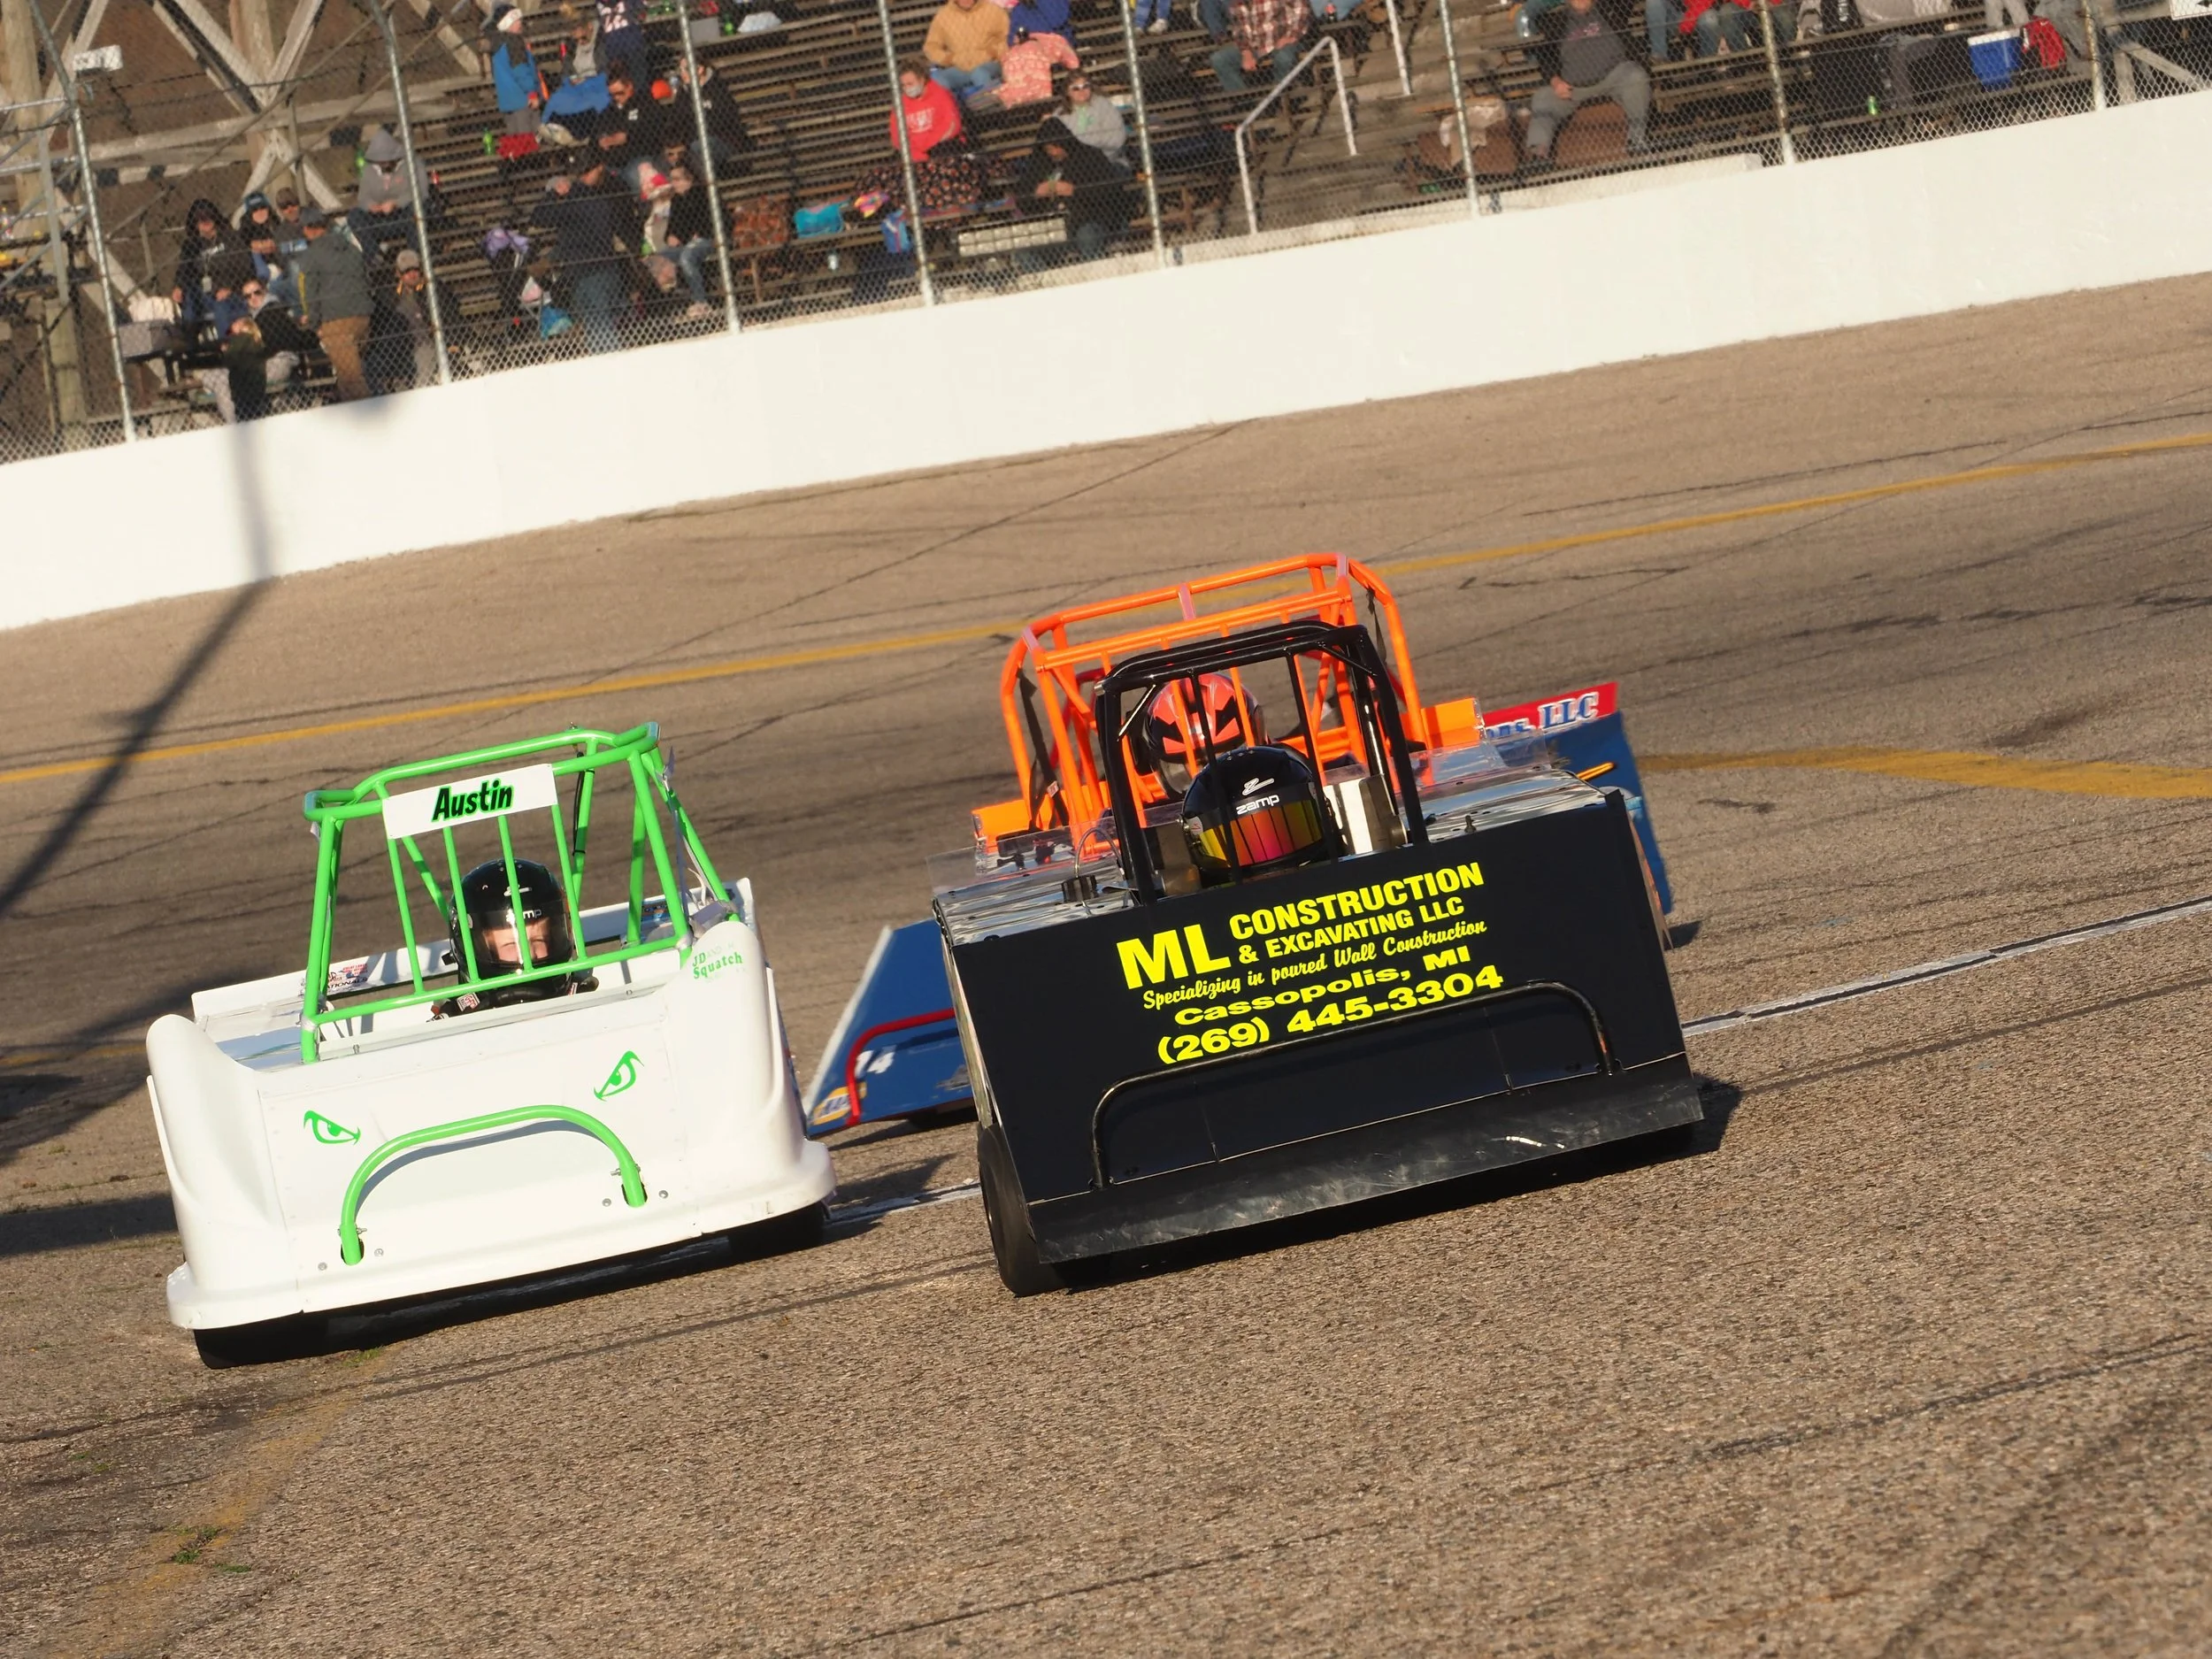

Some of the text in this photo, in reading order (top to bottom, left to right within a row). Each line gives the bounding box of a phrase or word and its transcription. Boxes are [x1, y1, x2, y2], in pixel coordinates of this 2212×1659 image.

[1539, 692, 1600, 733] LLC
[431, 778, 515, 823] Austin
[1235, 794, 1280, 816] zamp
[1228, 862, 1485, 940] CONSTRUCTION
[1116, 923, 1232, 990] ML
[1238, 895, 1465, 964] & EXCAVATING LLC
[327, 976, 368, 989] TIONALS
[692, 952, 706, 966] JD
[692, 952, 743, 979] Squatch
[1142, 918, 1487, 1010] Specializing in poured Wall Construction
[1174, 945, 1471, 1026] Cassopolis, MI
[1157, 964, 1504, 1064] (269) 445-3304
